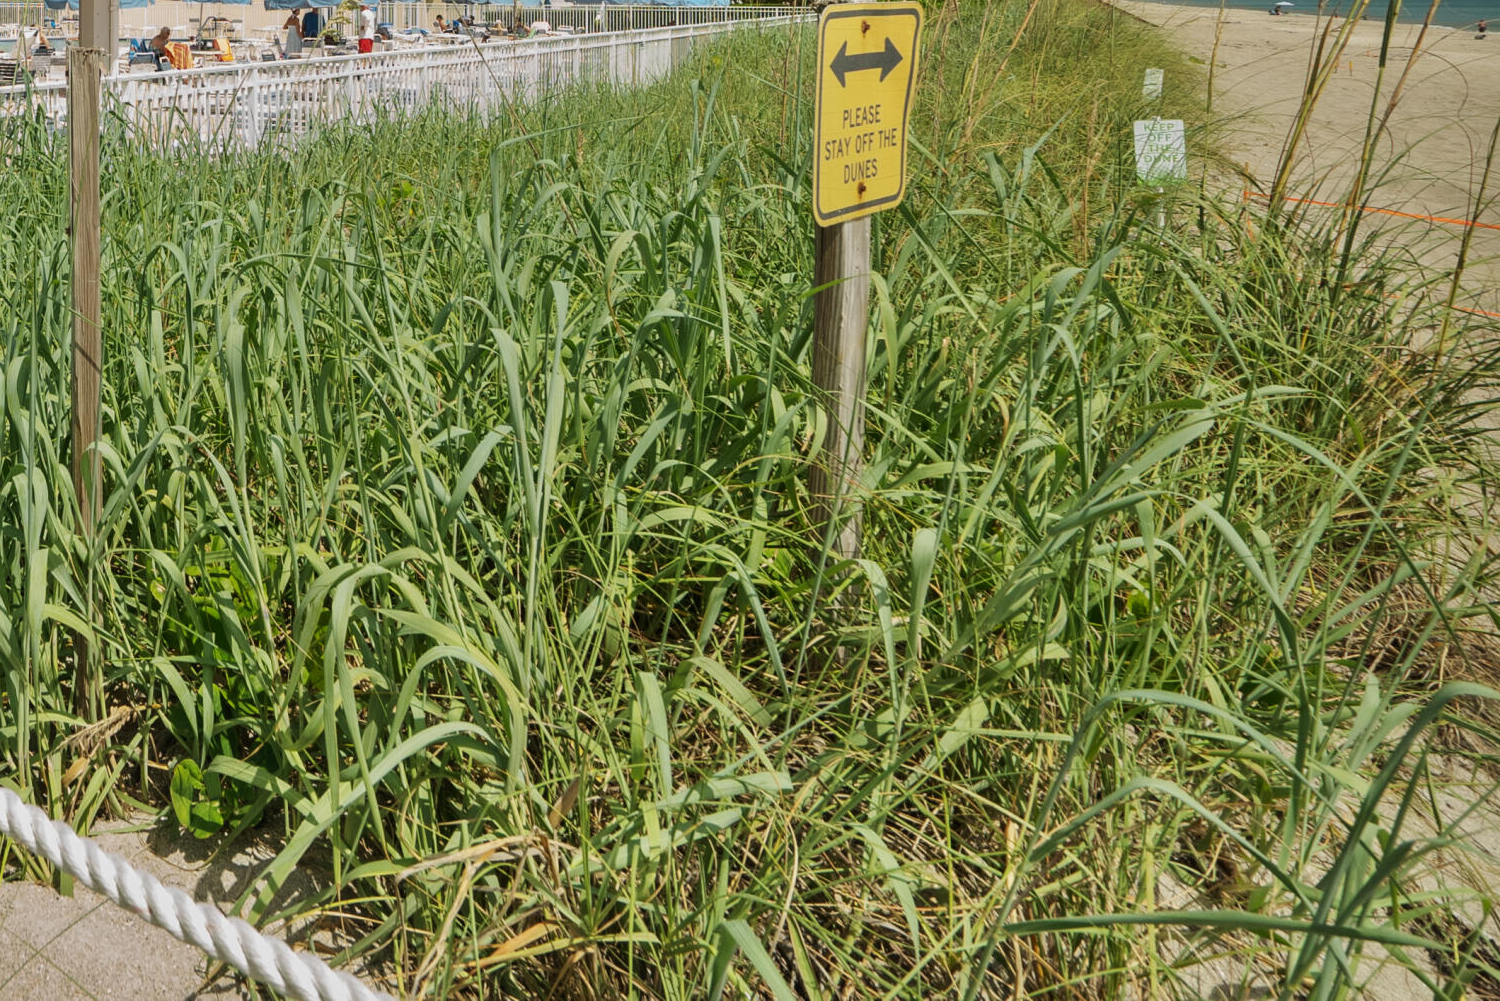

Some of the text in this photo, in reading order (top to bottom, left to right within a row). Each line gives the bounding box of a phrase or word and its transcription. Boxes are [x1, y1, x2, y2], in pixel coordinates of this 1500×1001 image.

[843, 104, 881, 129] PLEASE
[1144, 123, 1174, 131] KEEP
[824, 128, 898, 161] STAY OFF THE
[1148, 133, 1171, 142] OFF
[1148, 144, 1173, 152] THE
[843, 158, 878, 184] DUNES
